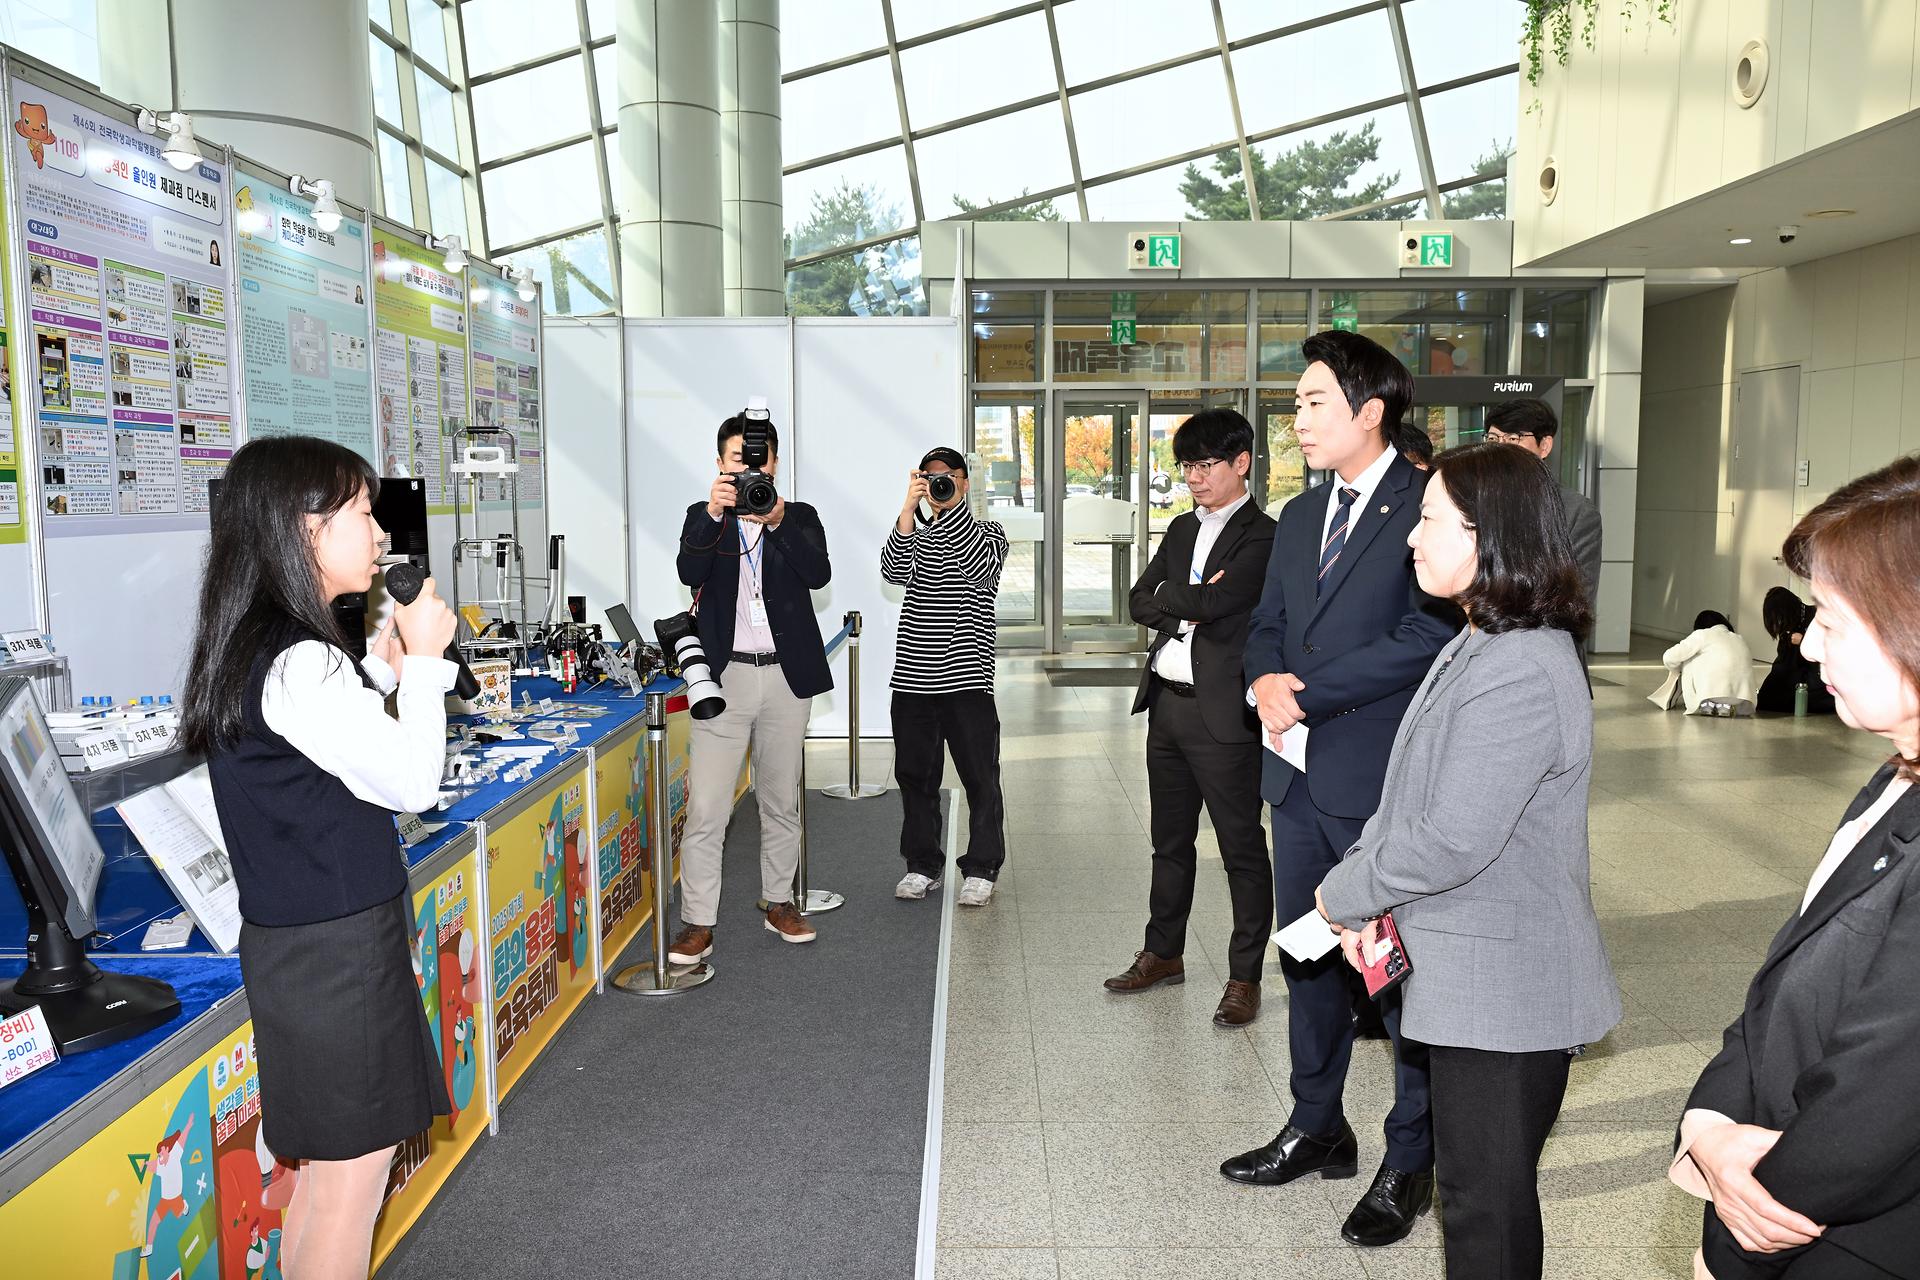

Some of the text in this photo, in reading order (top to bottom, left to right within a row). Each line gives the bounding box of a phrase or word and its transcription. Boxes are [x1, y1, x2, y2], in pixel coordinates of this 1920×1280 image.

[73, 113, 168, 162] 제46회 전국학생과학발명품경
[133, 166, 157, 190] 올인원
[160, 176, 183, 199] 제과점
[186, 186, 217, 212] 디스펜서
[10, 637, 43, 653] 3차 작품
[135, 725, 168, 744] 5차 작품
[85, 739, 119, 759] 4차 작품
[235, 1047, 242, 1062] M
[5, 1065, 23, 1081] 산소
[218, 1060, 225, 1075] S
[217, 1084, 244, 1123] 생각을
[217, 1112, 237, 1146] 꿈을
